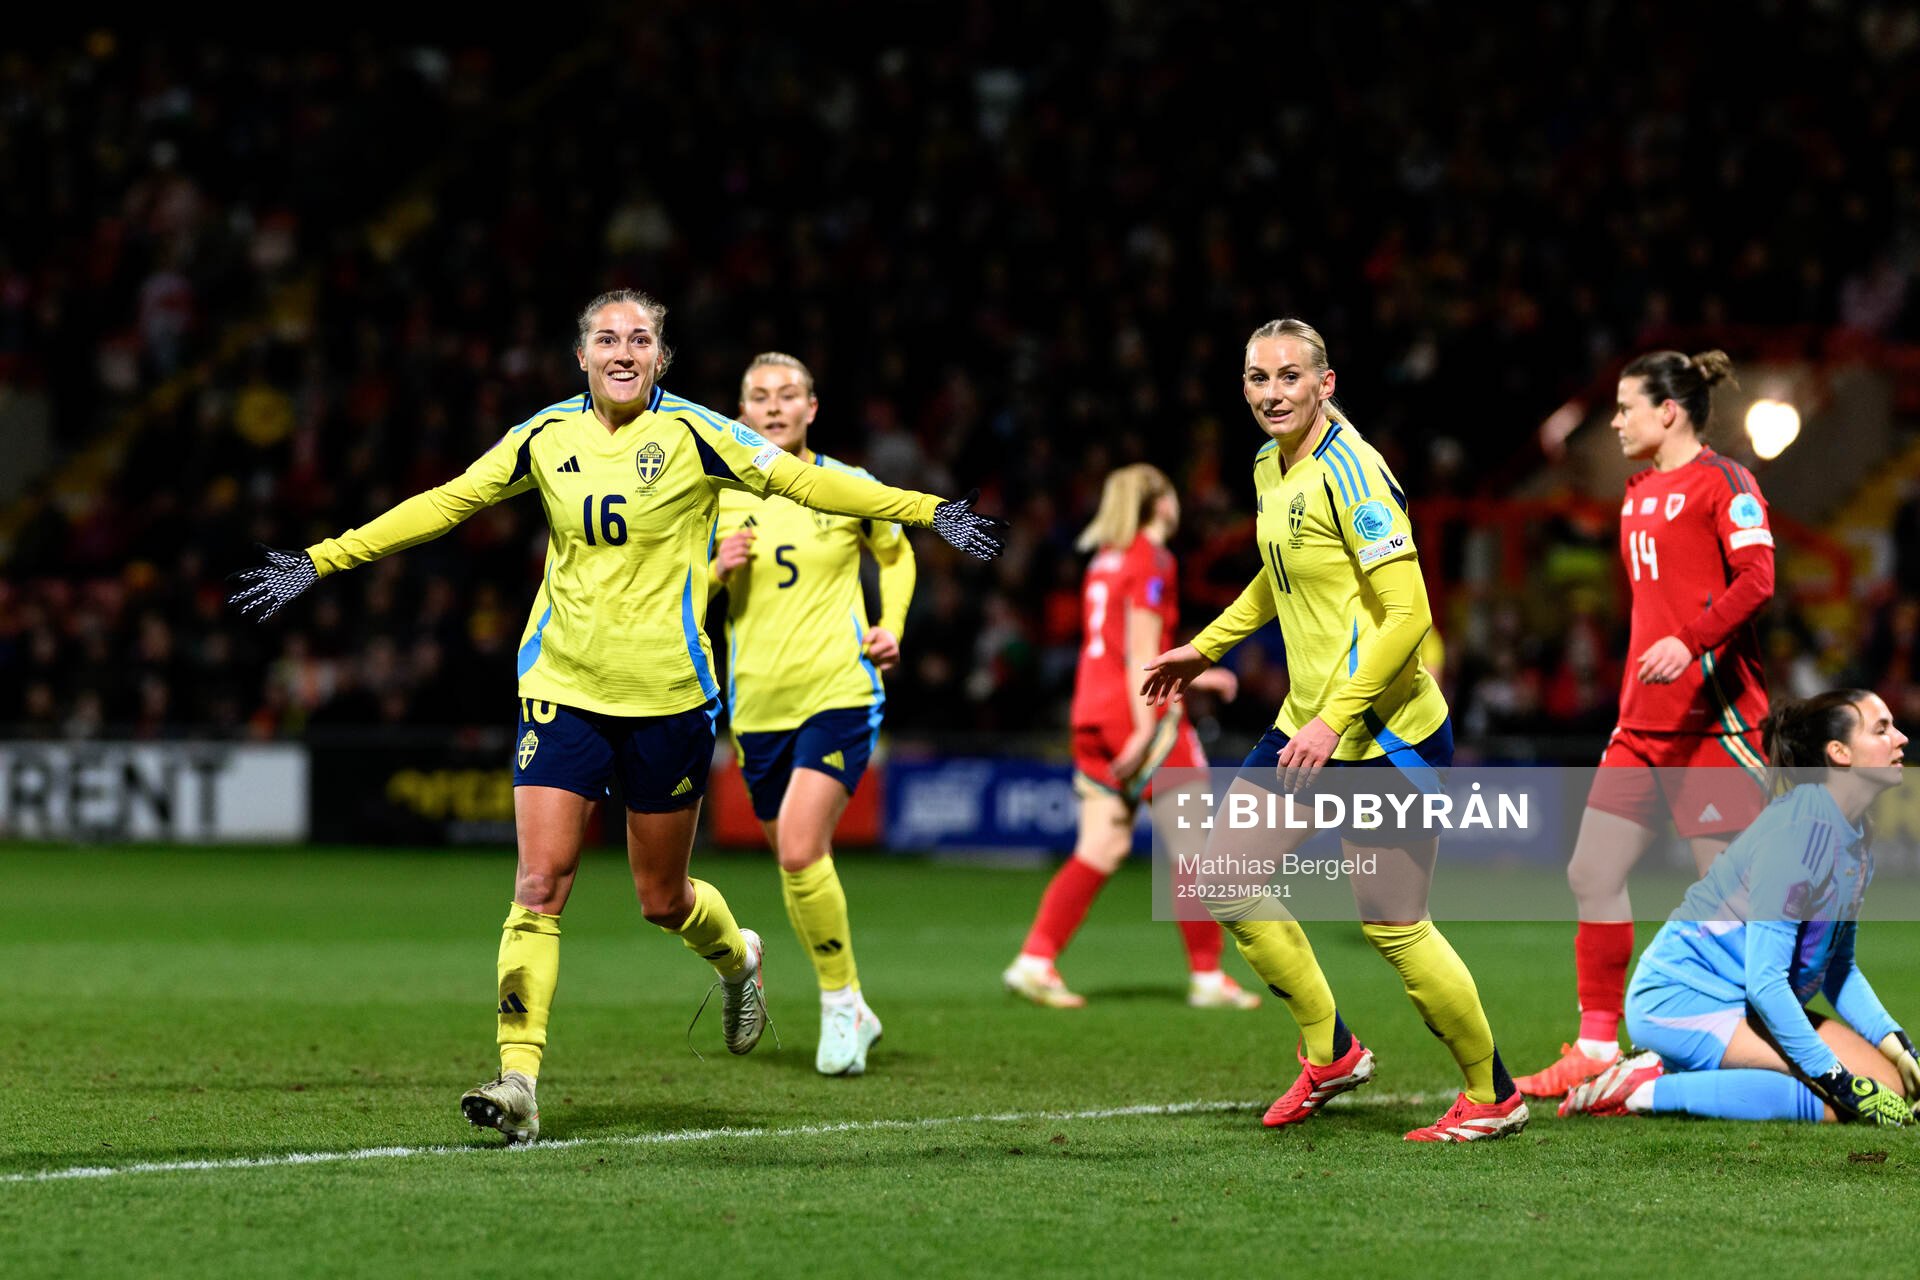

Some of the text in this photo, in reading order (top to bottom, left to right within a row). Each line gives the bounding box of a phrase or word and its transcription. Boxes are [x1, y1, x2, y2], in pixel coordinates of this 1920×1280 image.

[583, 494, 628, 546] 16
[775, 545, 799, 588] 5
[1268, 541, 1292, 594] 11
[1629, 530, 1659, 581] 14
